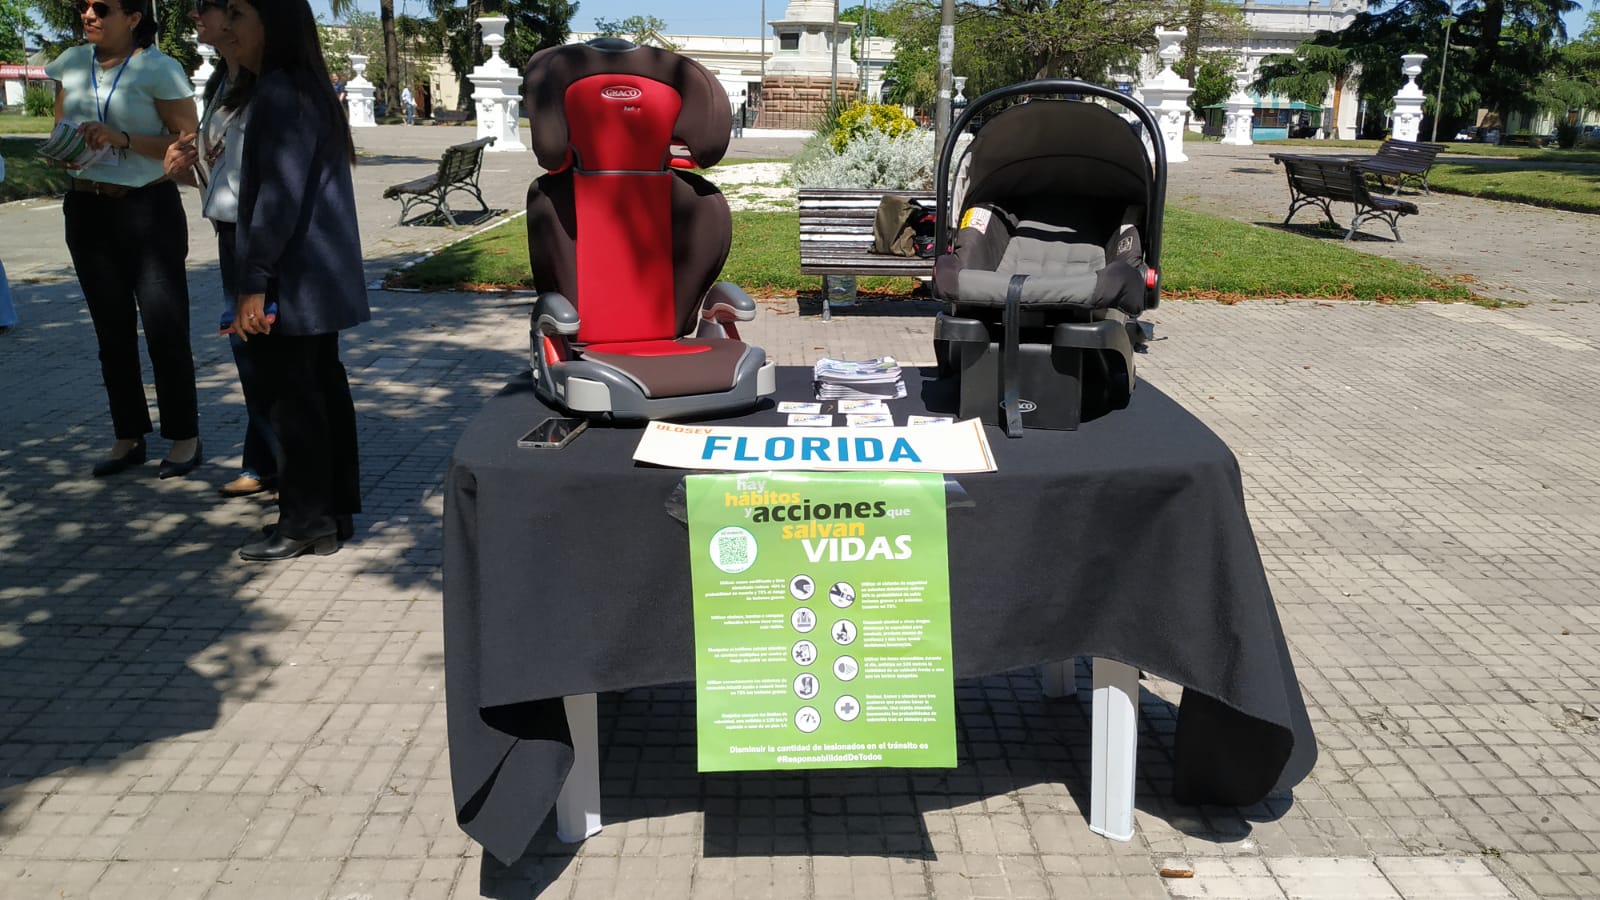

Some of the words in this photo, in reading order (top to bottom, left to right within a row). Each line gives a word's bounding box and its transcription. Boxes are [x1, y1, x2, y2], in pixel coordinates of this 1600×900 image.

[605, 88, 637, 97] GRACO
[701, 435, 922, 463] FLORIDA
[736, 478, 766, 493] hay
[725, 491, 800, 507] hábitos
[745, 507, 753, 518] y
[752, 499, 886, 523] acciones
[886, 507, 911, 519] que
[782, 520, 865, 540] salvan
[801, 534, 912, 563] VIDAS
[729, 745, 765, 753] Disminuir
[777, 744, 810, 752] cantidad
[823, 743, 865, 751] lesionados
[887, 741, 918, 749] tránsito
[777, 753, 882, 763] #ResponsabilidadDeTodos
